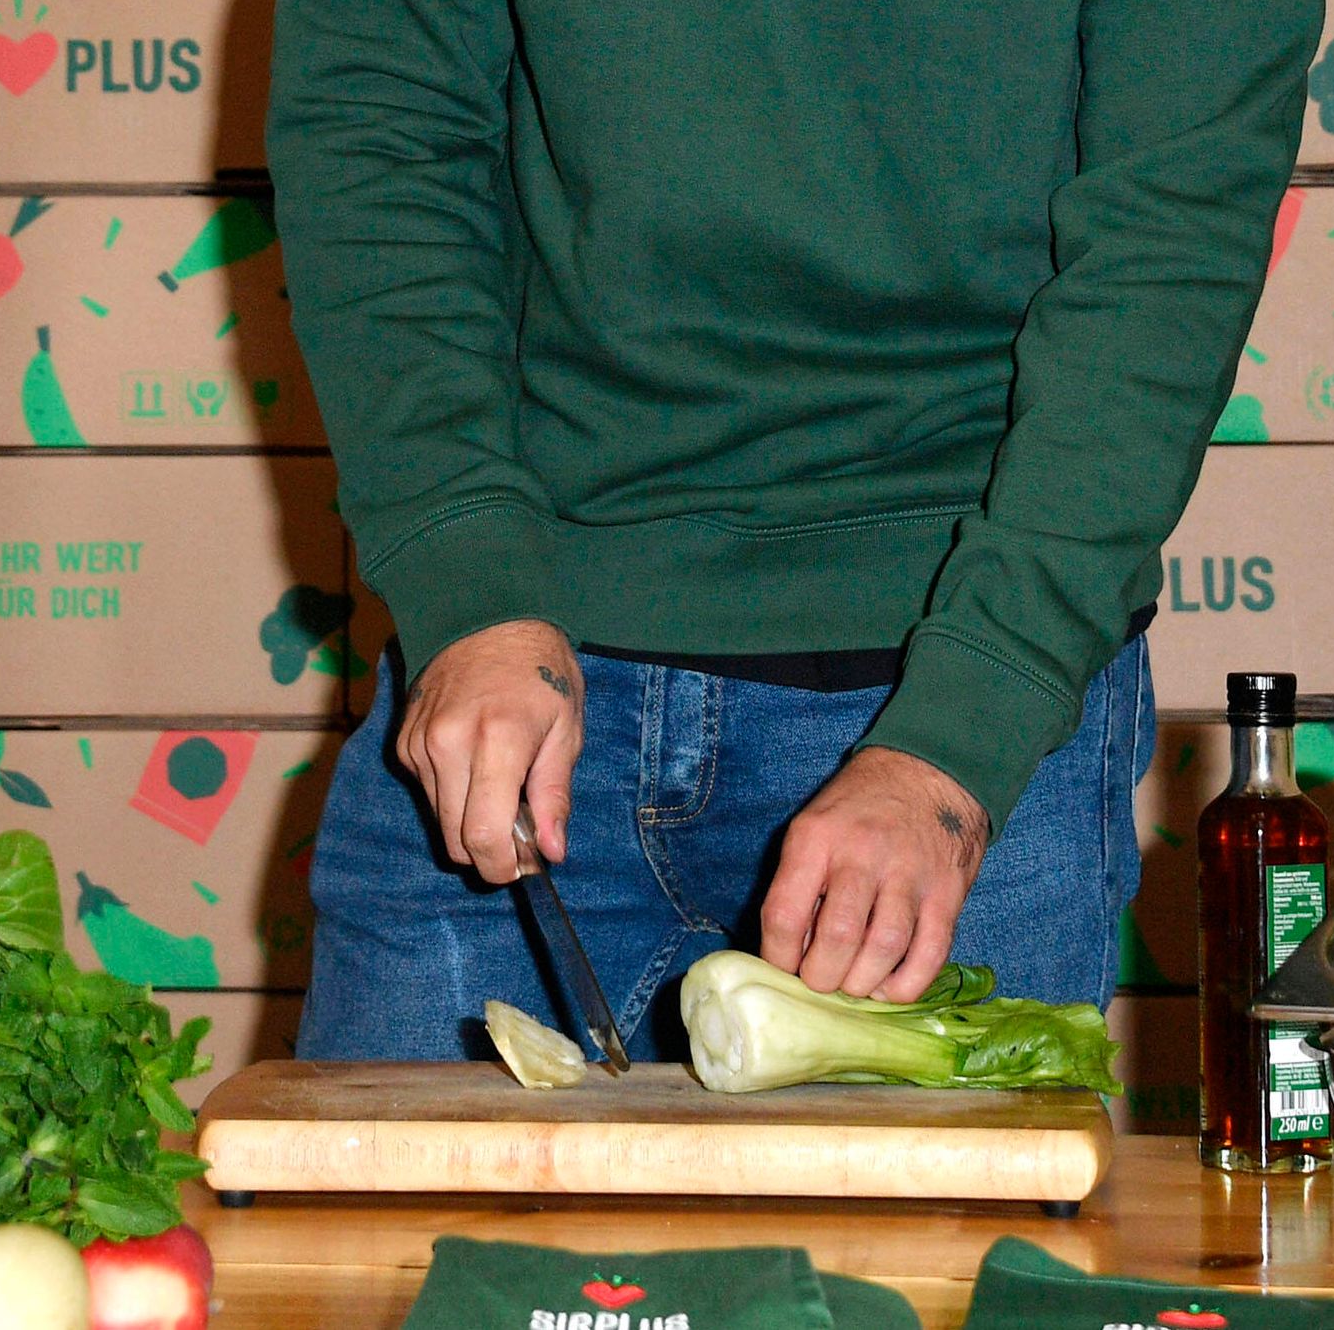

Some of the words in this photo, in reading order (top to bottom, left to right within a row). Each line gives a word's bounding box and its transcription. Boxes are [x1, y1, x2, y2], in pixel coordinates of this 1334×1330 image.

[65, 38, 202, 95] PLUS
[55, 540, 143, 575] WERT
[1168, 555, 1276, 612] LUS
[50, 585, 121, 620] DICH
[1278, 1117, 1298, 1134] 250
[1297, 1116, 1310, 1131] ml
